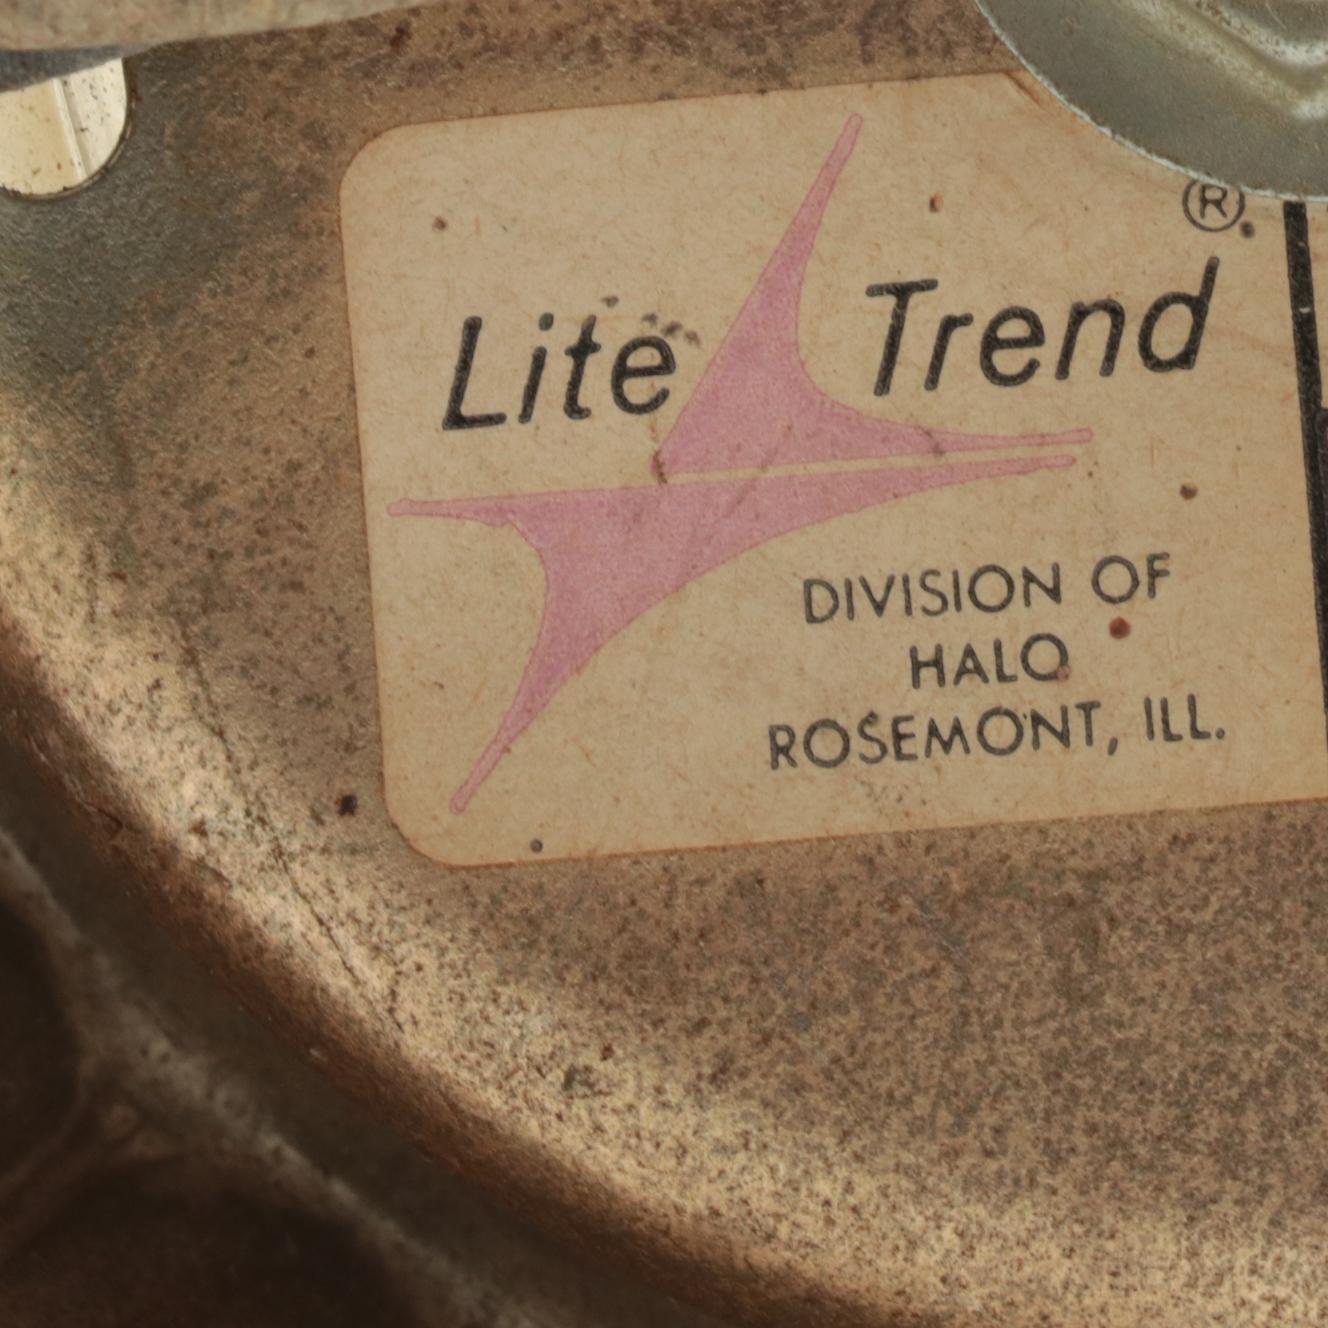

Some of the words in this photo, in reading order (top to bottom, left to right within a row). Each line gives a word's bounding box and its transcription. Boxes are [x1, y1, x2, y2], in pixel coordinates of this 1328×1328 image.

[442, 312, 678, 430] Lite
[866, 256, 1220, 396] Trend
[802, 562, 1063, 625] DIVISION
[1090, 551, 1171, 606] OF
[909, 632, 1071, 690] HALO
[768, 699, 1120, 771] ROSEMONT,
[1143, 693, 1227, 744] ILL.
